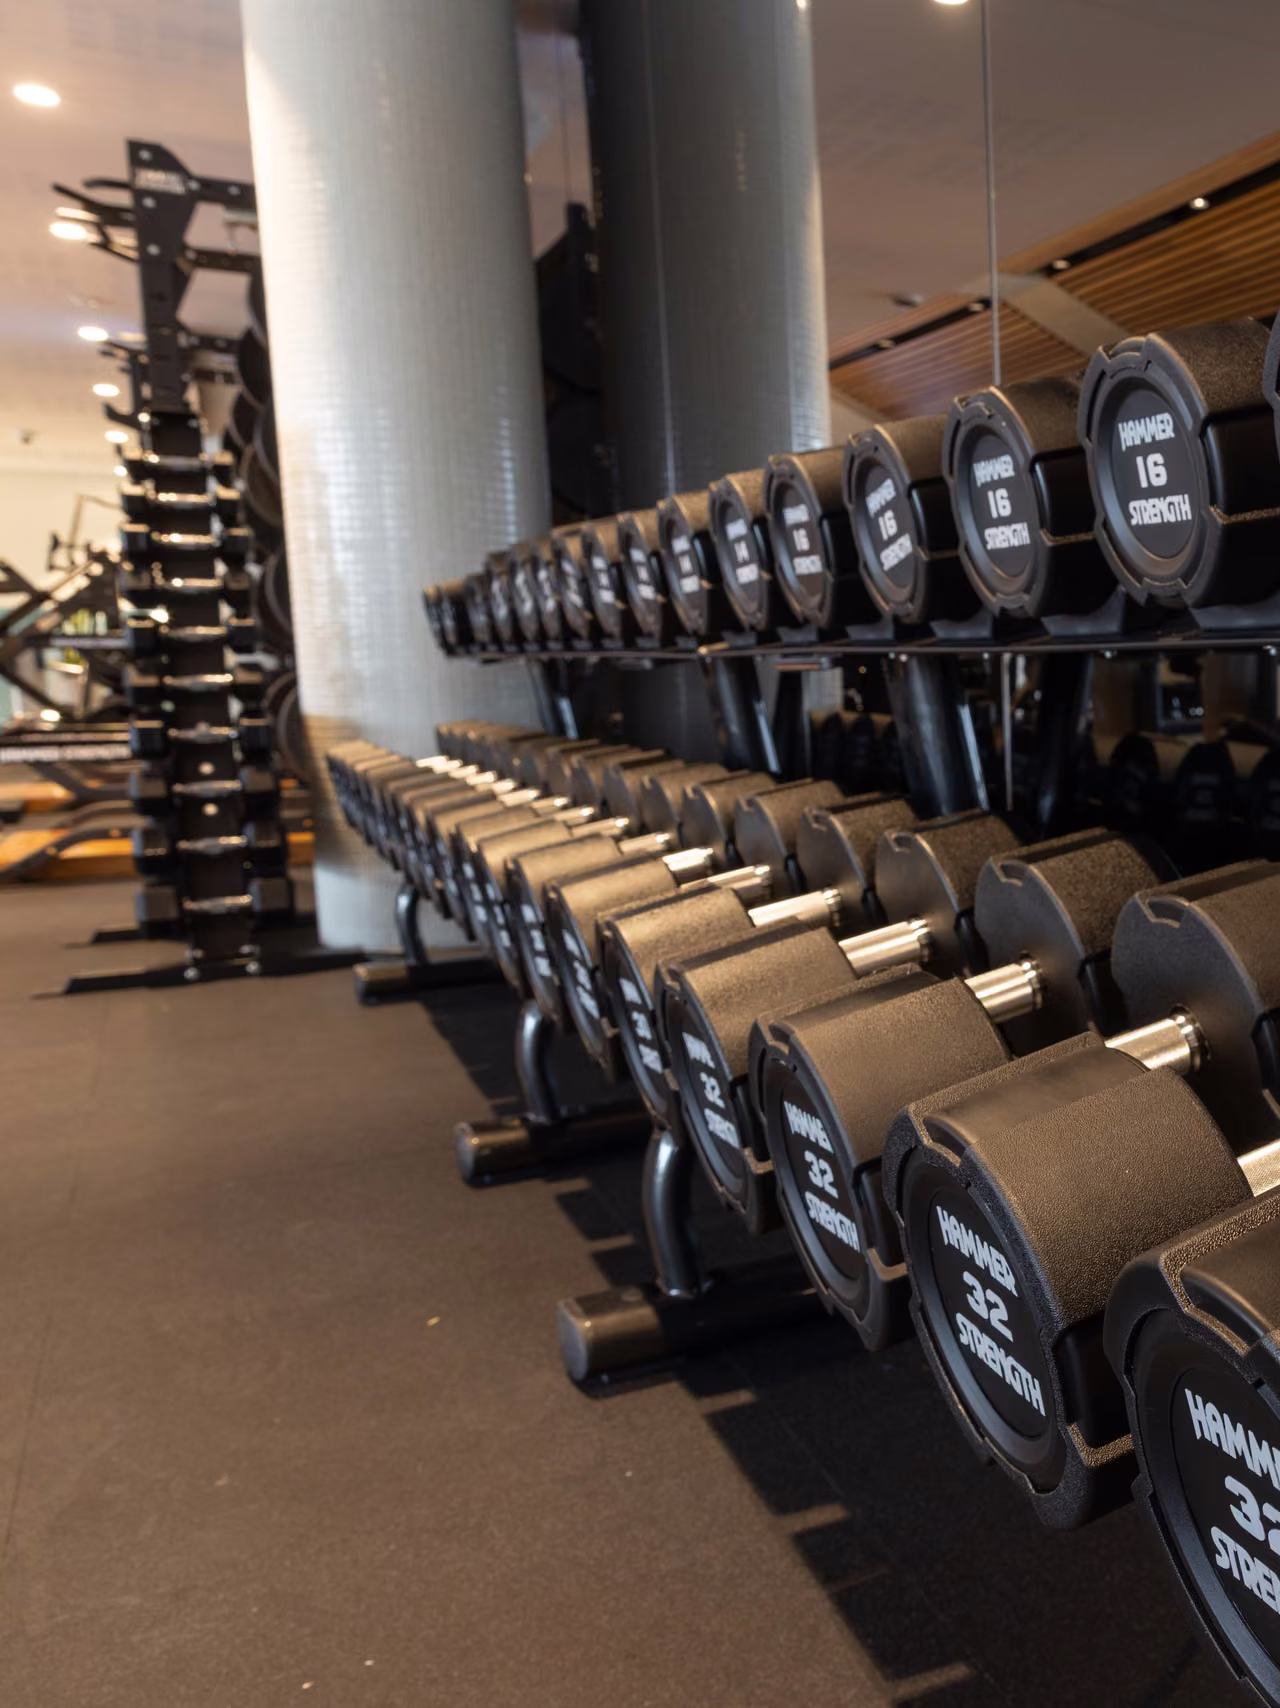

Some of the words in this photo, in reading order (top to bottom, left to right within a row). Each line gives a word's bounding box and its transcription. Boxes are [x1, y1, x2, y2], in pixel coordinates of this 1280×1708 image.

[1118, 412, 1176, 452] HAMMER
[1135, 452, 1168, 489] 16
[987, 487, 1012, 519] 16
[1128, 493, 1192, 526] STRENGTH
[804, 1150, 839, 1199] 32
[936, 1205, 1019, 1297] HAMMER
[962, 1270, 1014, 1343] 32
[955, 1312, 1046, 1417] STRENGTH
